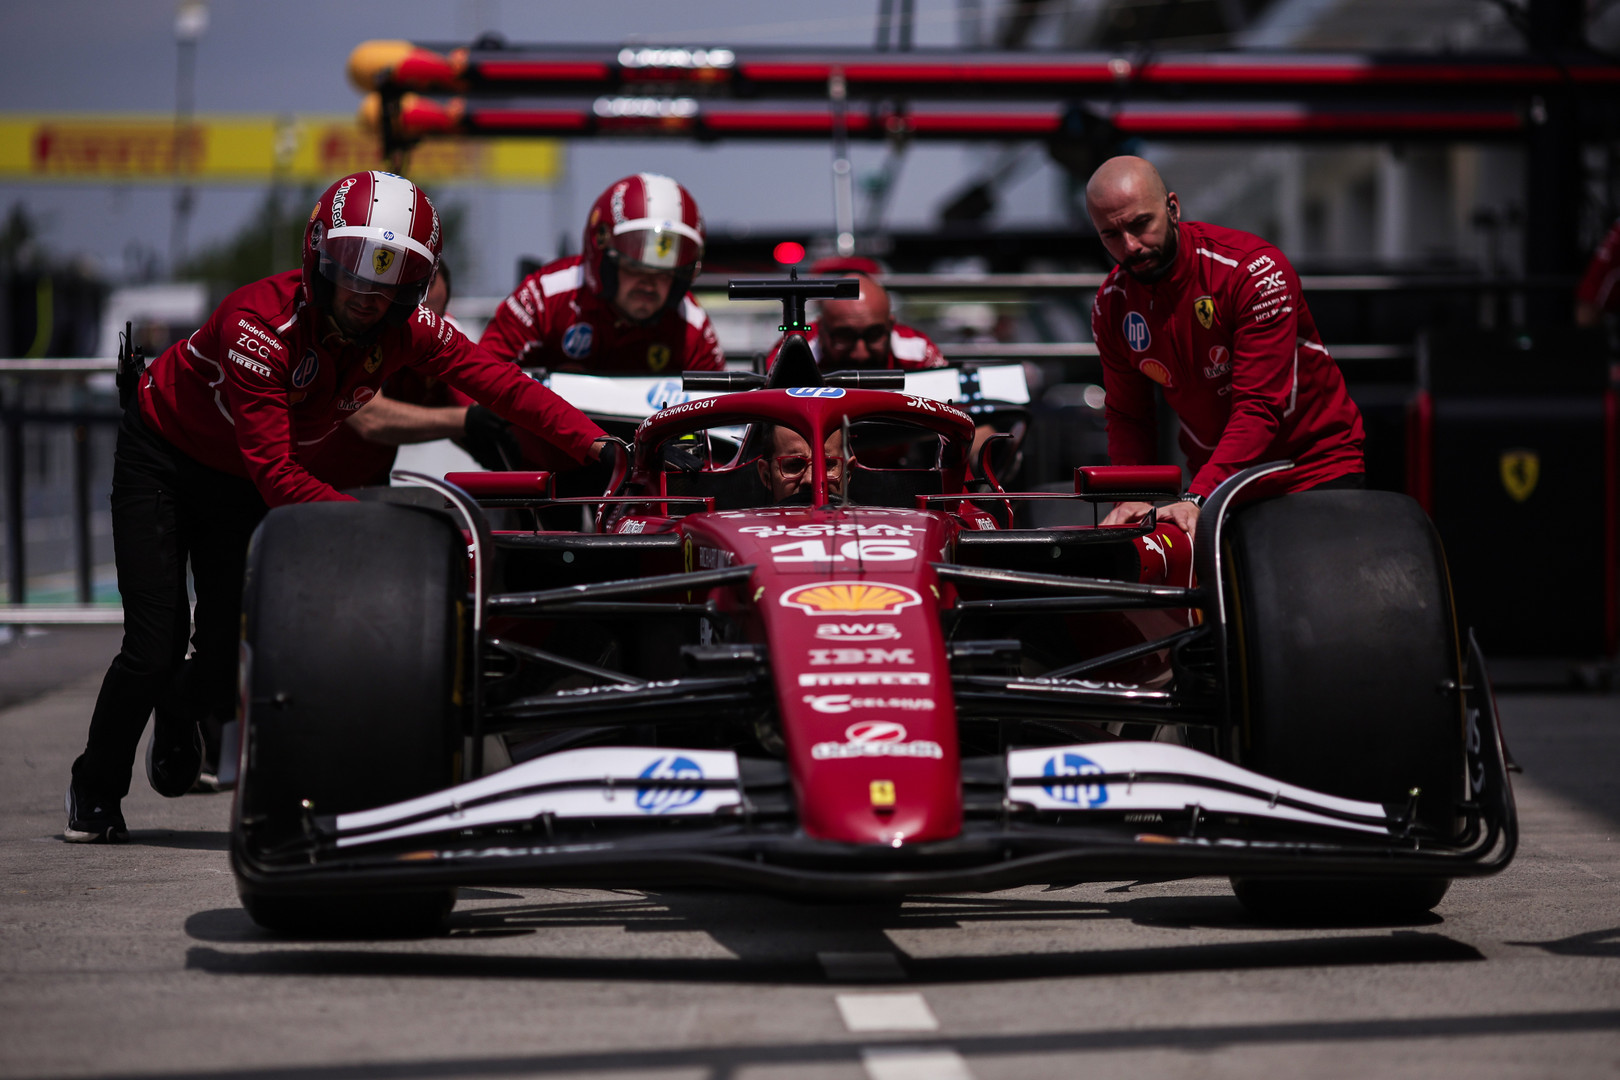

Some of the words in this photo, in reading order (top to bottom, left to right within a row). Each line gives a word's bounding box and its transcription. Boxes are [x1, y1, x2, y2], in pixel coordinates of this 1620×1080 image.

[331, 186, 350, 228] UniCredi
[1247, 255, 1271, 273] aws
[1252, 298, 1280, 312] RICHARD
[238, 318, 283, 352] Bitdefender
[564, 321, 592, 359] hp
[1126, 312, 1147, 351] hp
[236, 332, 271, 359] ZCG
[227, 348, 272, 378] PIRELLI
[648, 379, 685, 408] hp
[791, 387, 840, 398] hp
[655, 398, 718, 421] TECHNOLOGY
[738, 523, 927, 533] GLOBAL
[755, 530, 914, 539] POKER
[770, 539, 918, 563] 16
[816, 622, 899, 637] aws
[808, 648, 915, 666] IBM
[798, 672, 931, 687] PIRELLI
[637, 754, 702, 814] hp
[1045, 752, 1103, 809] hp
